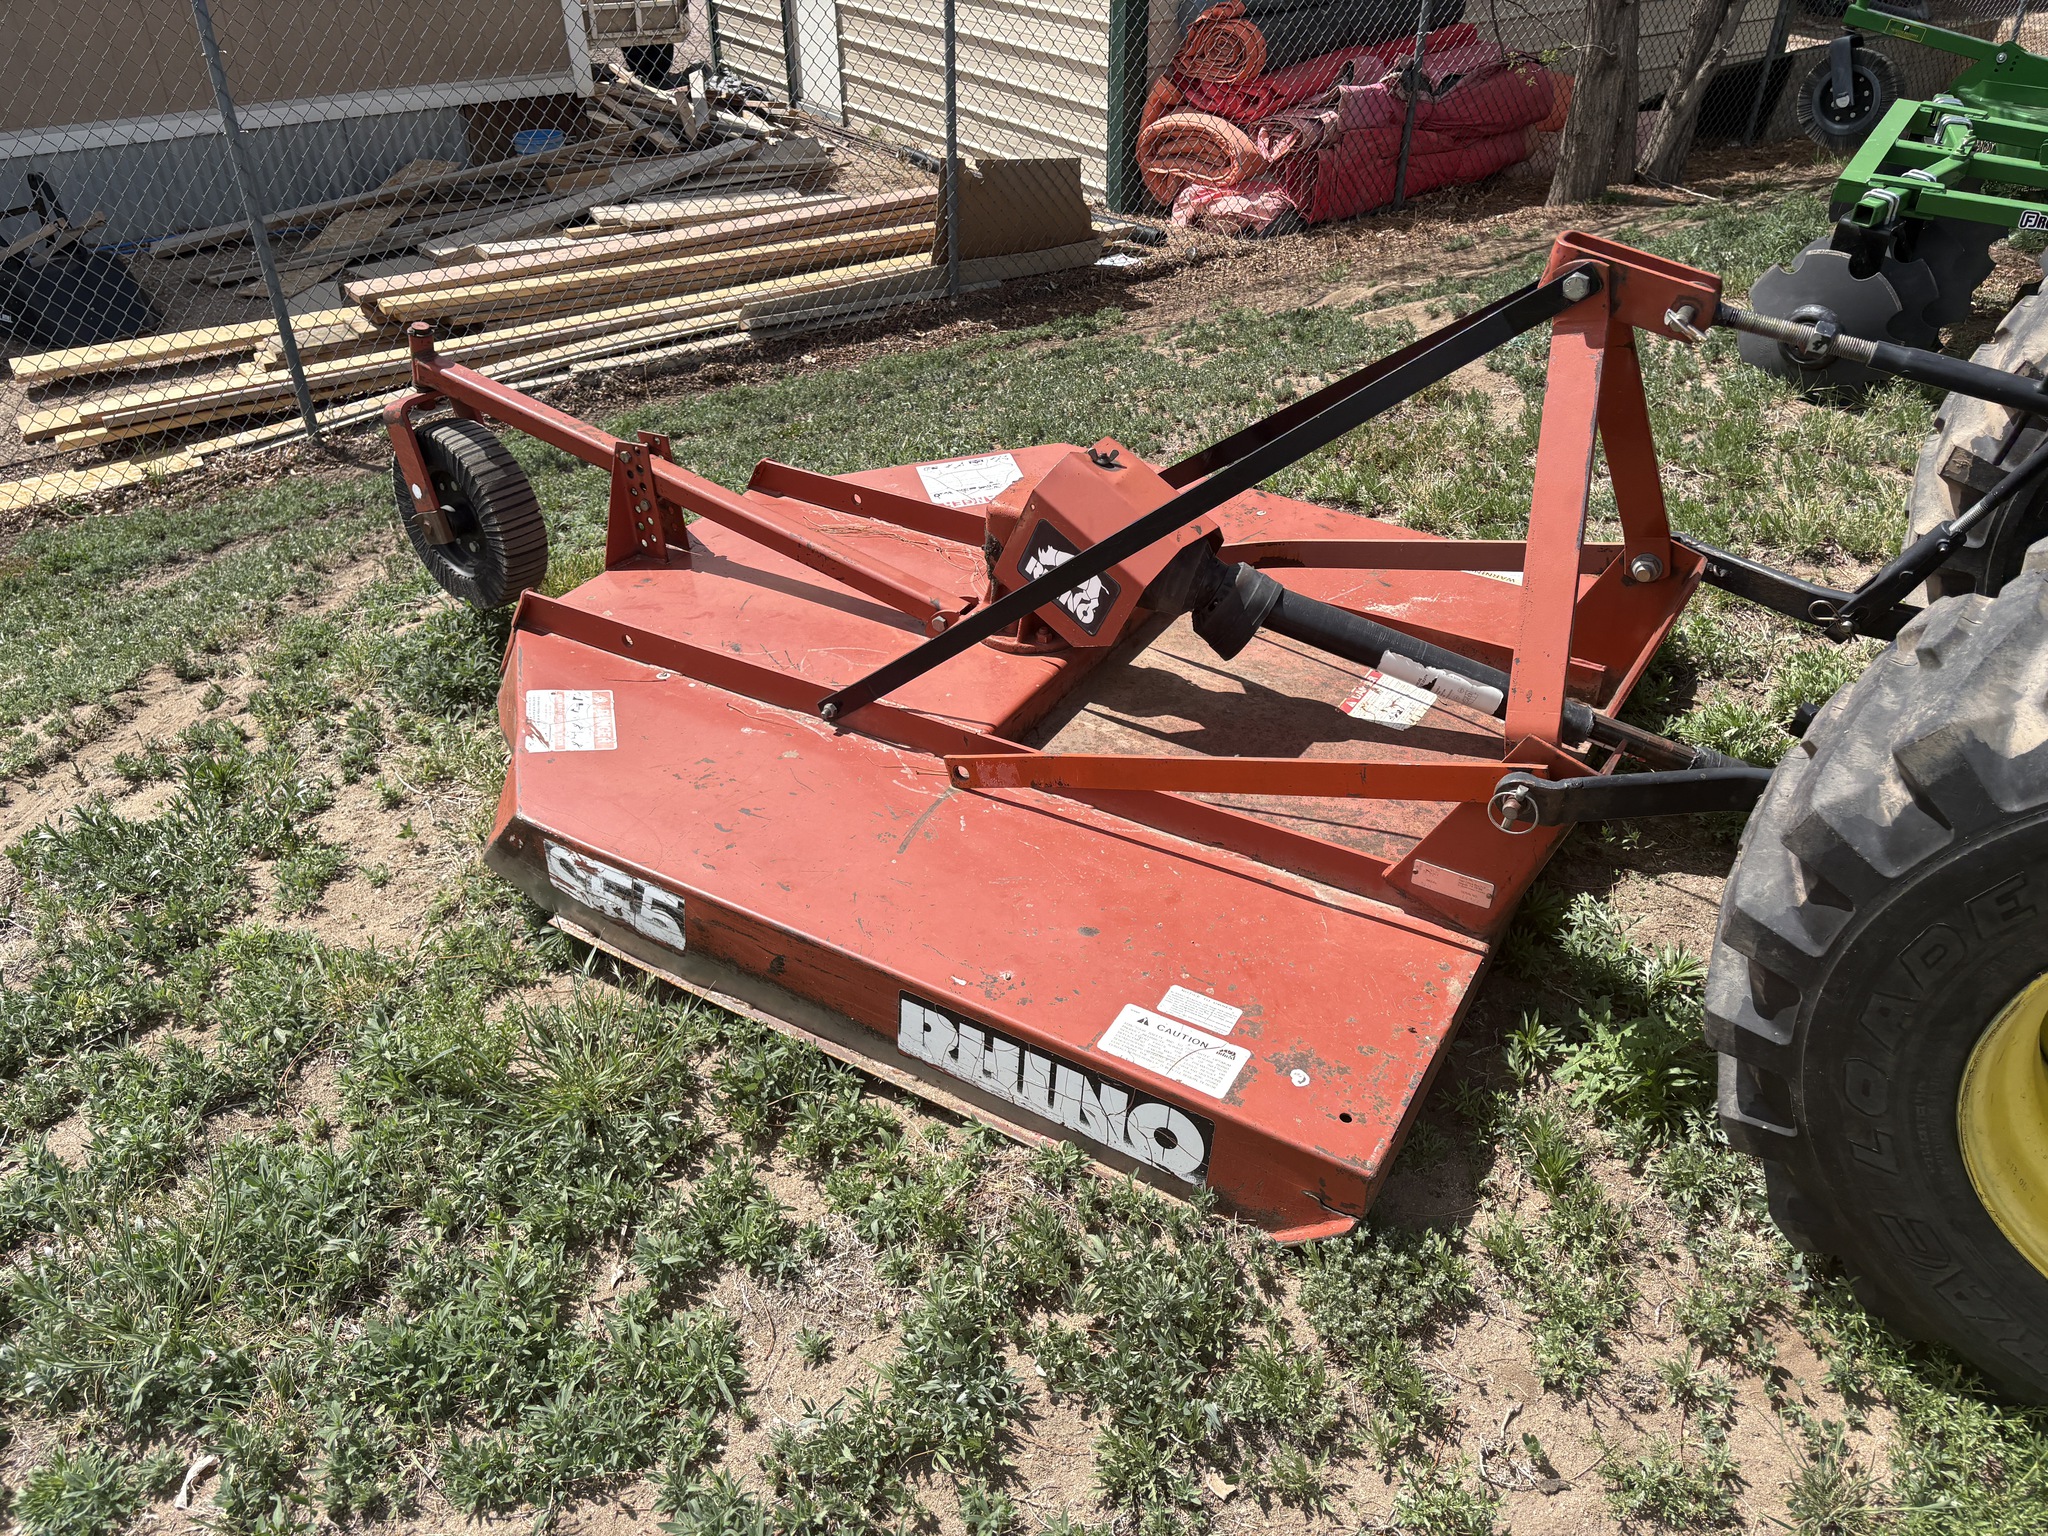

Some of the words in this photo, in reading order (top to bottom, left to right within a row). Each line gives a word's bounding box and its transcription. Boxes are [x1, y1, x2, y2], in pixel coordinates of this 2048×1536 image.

[2019, 210, 2048, 230] FR
[1156, 1023, 1209, 1049] CAUTION
[900, 997, 1206, 1176] RHINO
